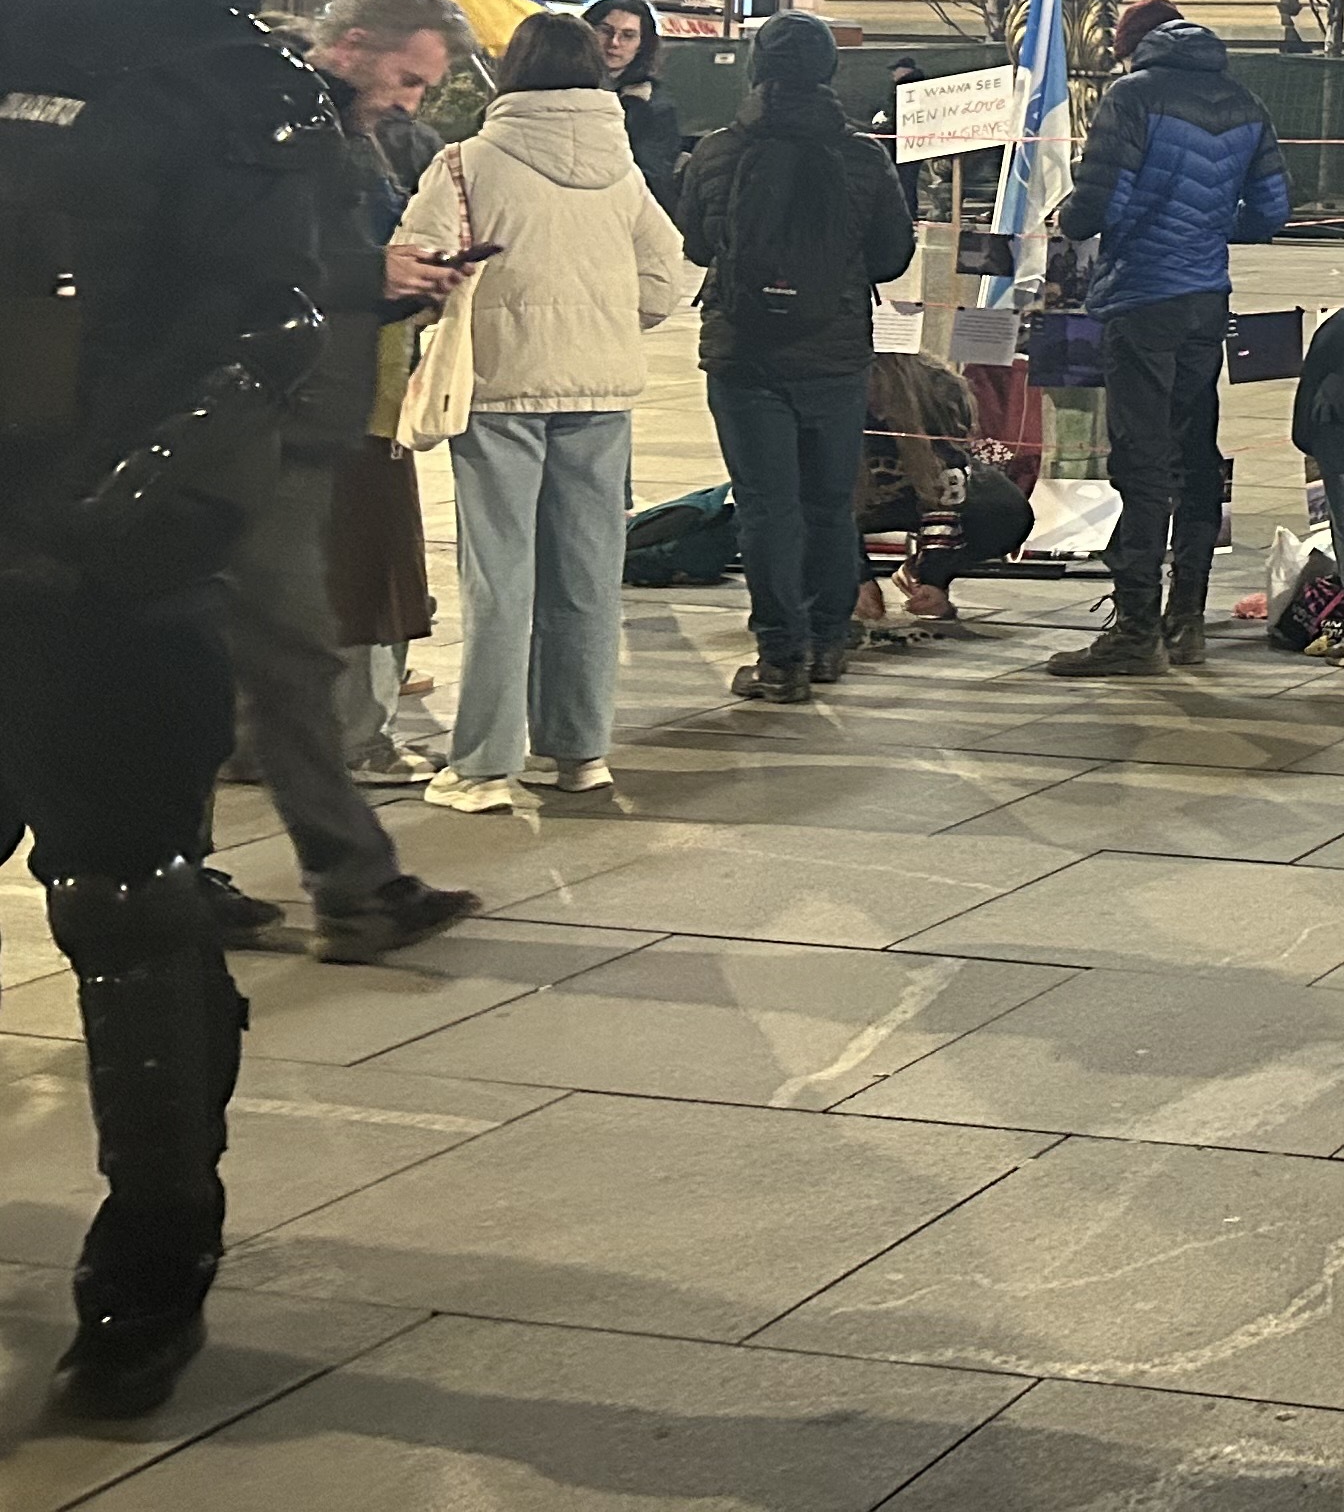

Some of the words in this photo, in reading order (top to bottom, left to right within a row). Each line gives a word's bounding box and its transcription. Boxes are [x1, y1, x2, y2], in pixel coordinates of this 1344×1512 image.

[905, 89, 916, 104] I
[923, 82, 972, 98] WANNA
[975, 77, 1002, 91] SEE
[902, 109, 938, 127] MEN
[942, 105, 960, 118] IN
[903, 132, 936, 150] NOT
